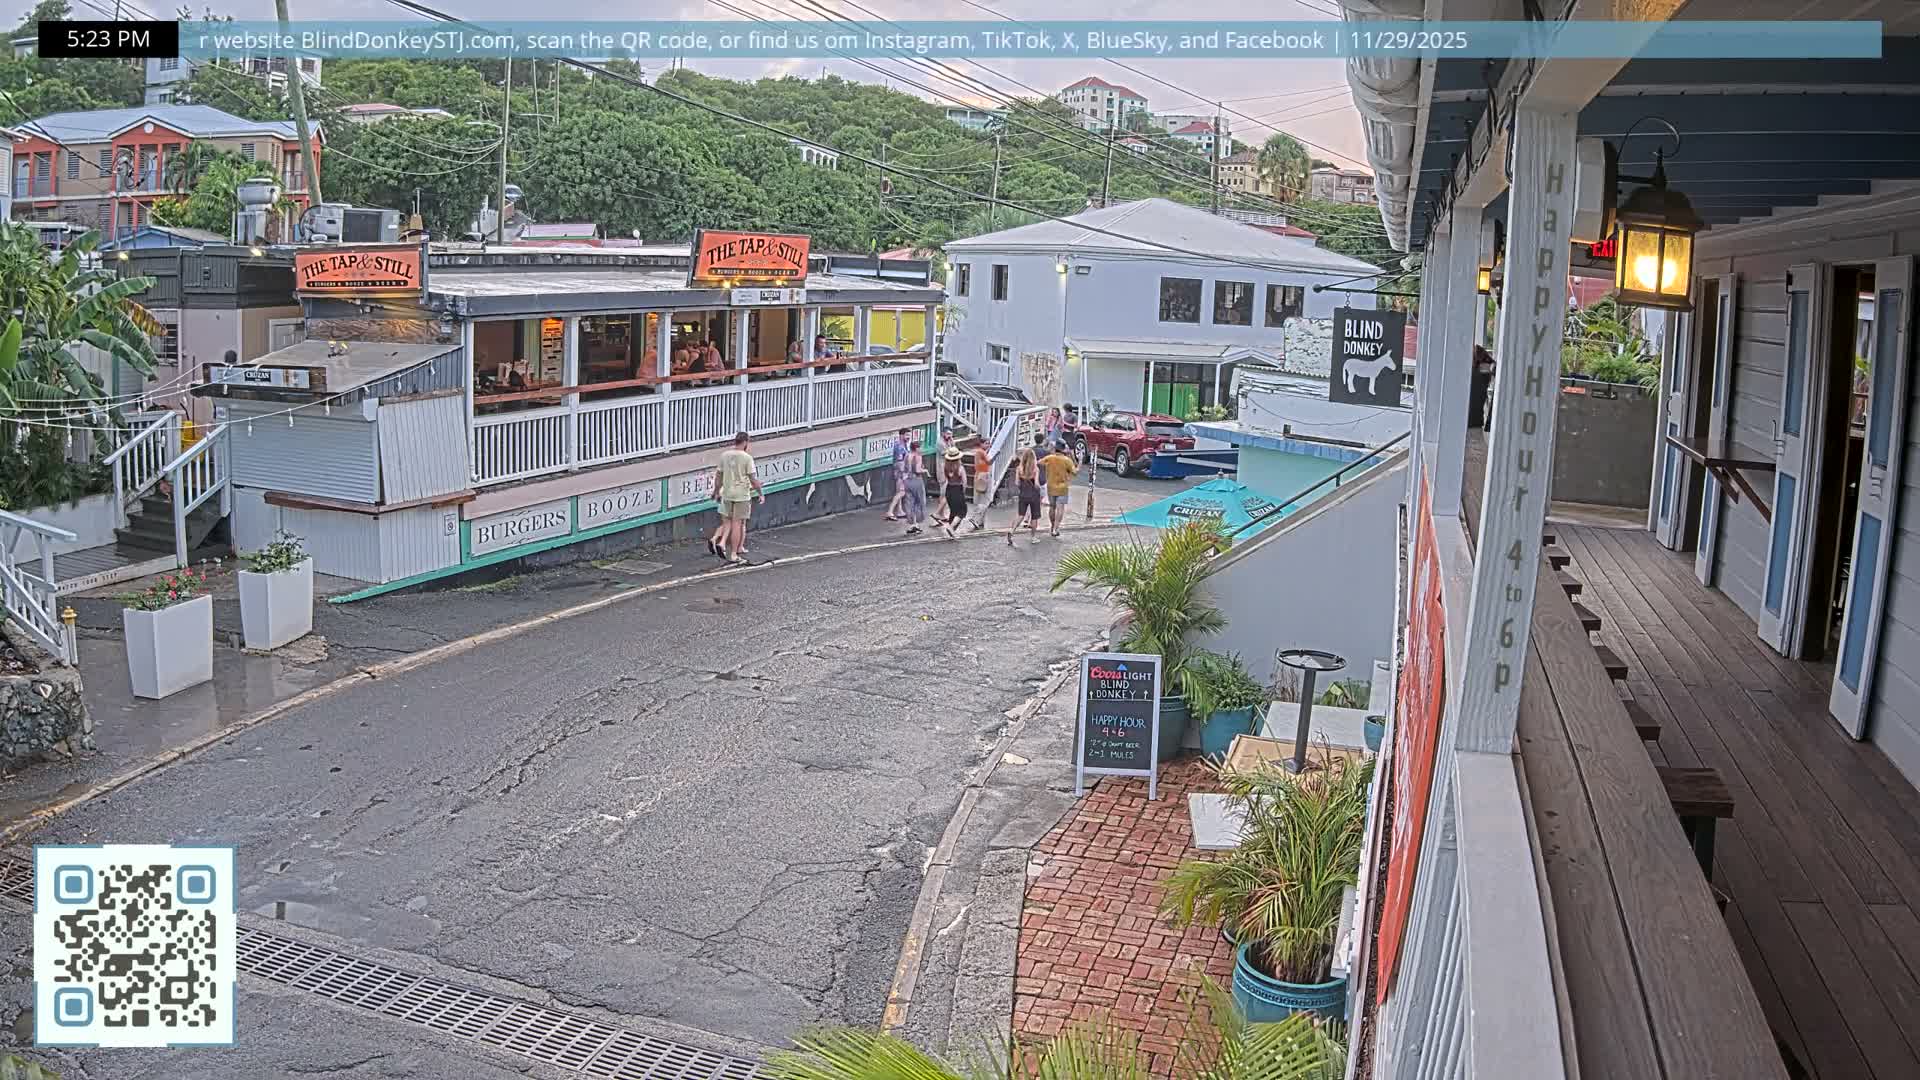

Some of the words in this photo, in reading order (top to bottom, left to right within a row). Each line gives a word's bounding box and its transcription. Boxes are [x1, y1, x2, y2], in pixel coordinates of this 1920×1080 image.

[707, 240, 737, 265] THE
[739, 238, 765, 255] TAP
[762, 238, 778, 256] &
[777, 242, 804, 268] STILL
[1591, 240, 1618, 257] EXI
[302, 259, 329, 280] THE
[329, 255, 358, 270] TAP
[356, 253, 374, 270] &
[374, 256, 414, 280] STILL
[1344, 319, 1384, 339] BLIND
[1343, 340, 1384, 356] DONKEY
[245, 371, 270, 379] CRUZAN
[820, 447, 855, 465] DOGS
[587, 488, 655, 518] BOOZE
[1173, 506, 1221, 519] CRUZAN
[478, 510, 567, 545] BURGERS
[1506, 539, 1522, 573] 4
[1505, 583, 1522, 602] to
[1090, 665, 1122, 680] Coors
[1123, 671, 1153, 681] LIGHT
[1101, 680, 1130, 689] BLIND
[1096, 689, 1137, 701] DONKEY
[1091, 713, 1118, 727] HAPPY
[1119, 716, 1147, 729] HOUR
